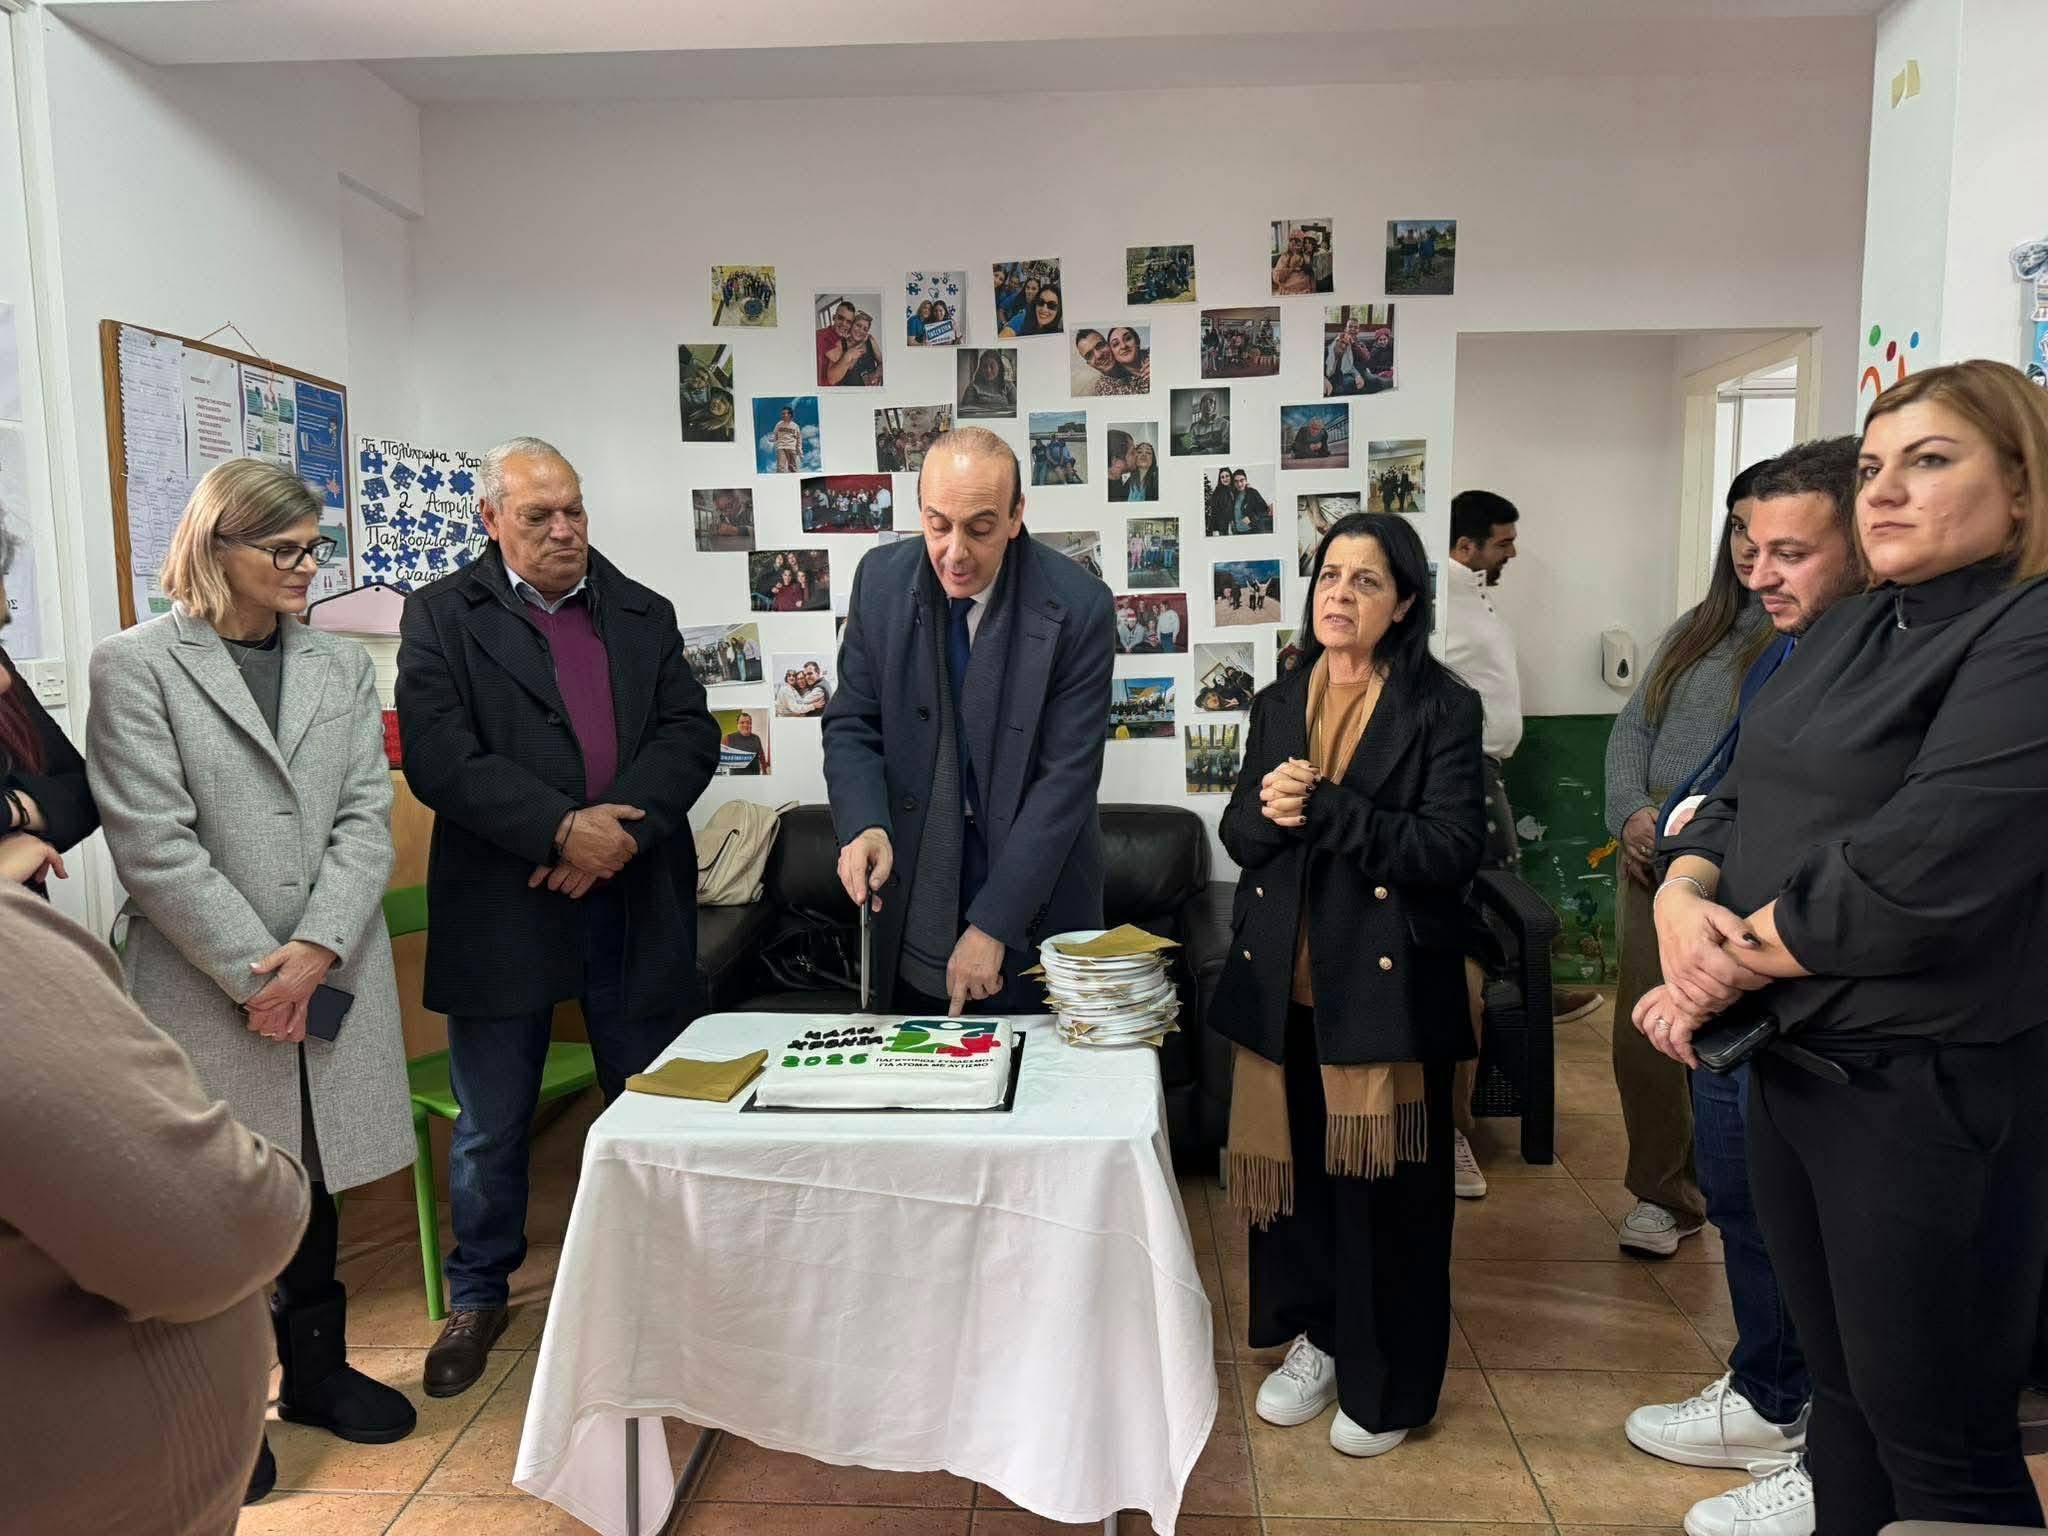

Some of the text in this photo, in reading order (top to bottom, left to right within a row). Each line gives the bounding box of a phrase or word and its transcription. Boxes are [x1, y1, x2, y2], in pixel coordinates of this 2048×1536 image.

[362, 438, 379, 453] Τα
[381, 440, 450, 467] Πολύχρωμα
[455, 451, 482, 472] Ψαρ
[399, 491, 481, 519] 2 Απριλίο
[365, 526, 451, 552] Παγκόσμια
[781, 1053, 869, 1067] 2026
